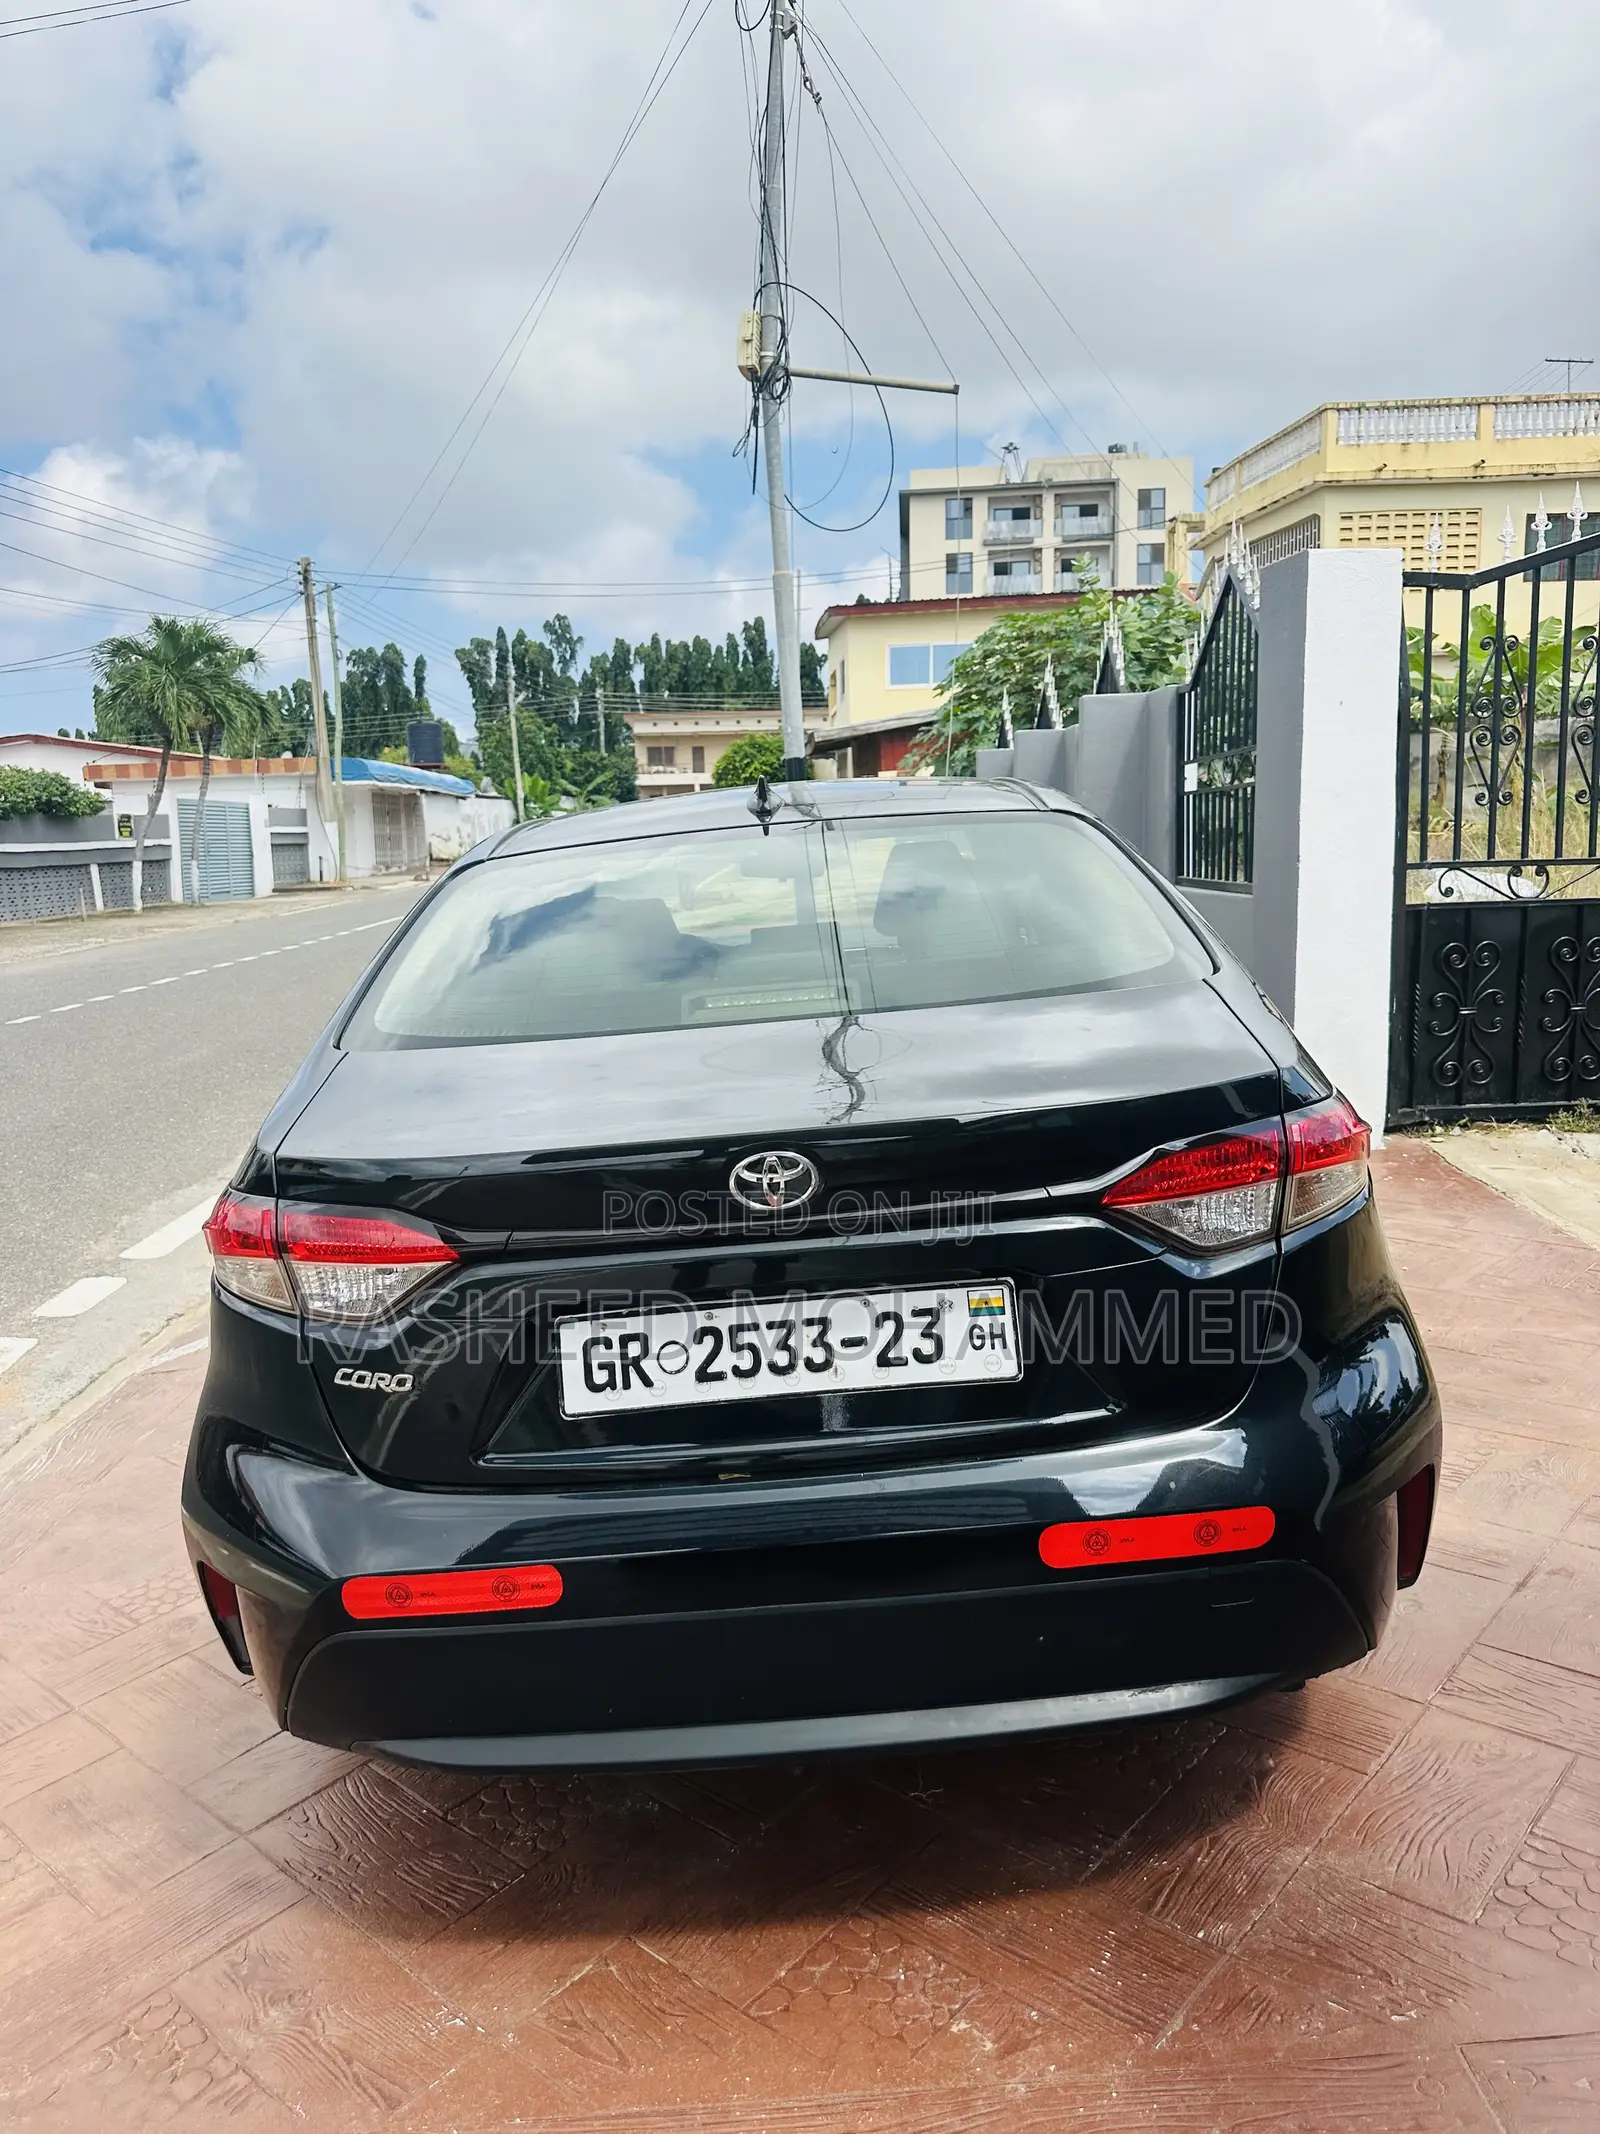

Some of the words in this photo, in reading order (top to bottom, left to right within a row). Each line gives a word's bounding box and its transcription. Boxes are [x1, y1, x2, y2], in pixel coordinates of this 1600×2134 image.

[582, 1331, 655, 1394] GR
[692, 1306, 944, 1384] 2533-23
[968, 1321, 1008, 1351] GH
[333, 1367, 414, 1393] CORO
